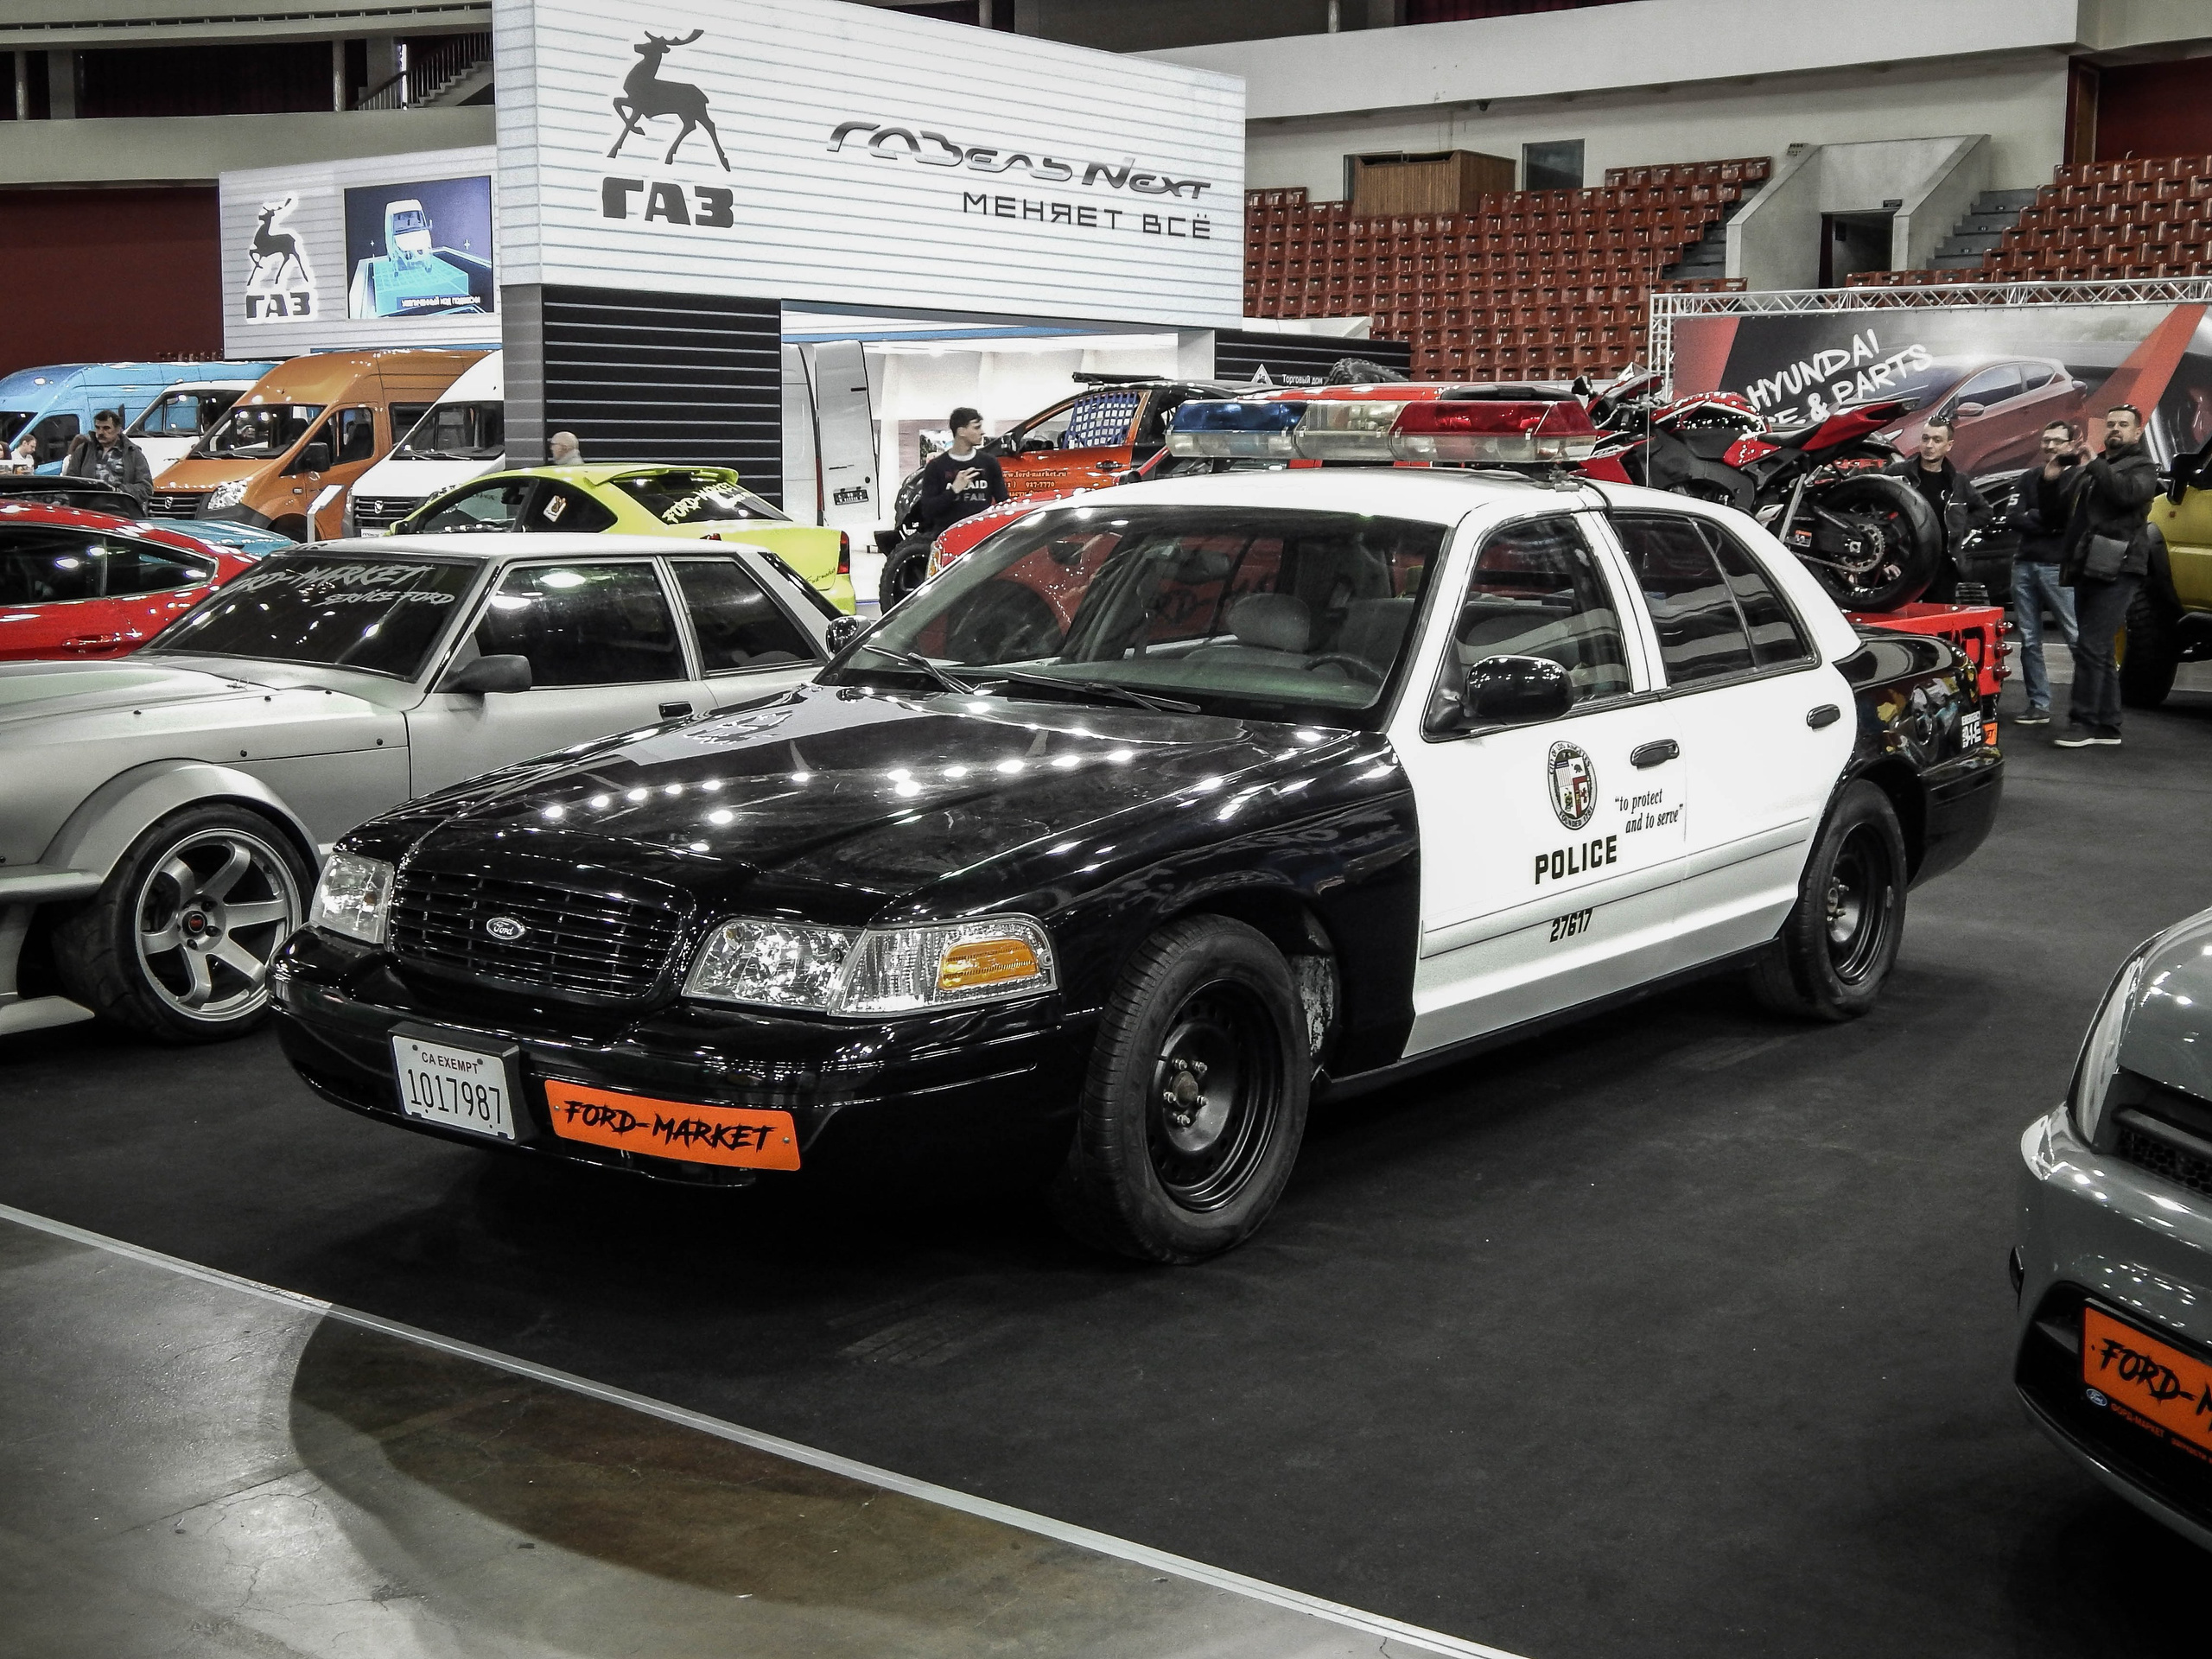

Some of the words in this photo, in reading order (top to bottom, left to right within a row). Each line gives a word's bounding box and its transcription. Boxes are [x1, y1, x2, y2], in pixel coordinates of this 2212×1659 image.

[602, 176, 734, 228] ГАЗ
[963, 192, 1122, 230] МЕНЯЕТ
[1142, 213, 1211, 239] ВСЁ
[245, 291, 311, 319] ГАЗ
[1282, 374, 1311, 385] Торговый
[1746, 328, 1879, 410] HYUNDAI
[1831, 344, 1934, 406] PARTS
[396, 591, 455, 605] FORD
[1630, 788, 1662, 814] protect
[1625, 812, 1643, 834] and
[1645, 812, 1655, 830] to
[1535, 834, 1618, 886] POLICE
[493, 920, 514, 936] Ford
[1549, 907, 1595, 943] 27617
[421, 1052, 436, 1065] CA
[437, 1055, 479, 1074] EXEMPT
[408, 1068, 501, 1124] 1017987
[563, 1099, 776, 1153] FORD-MARKET
